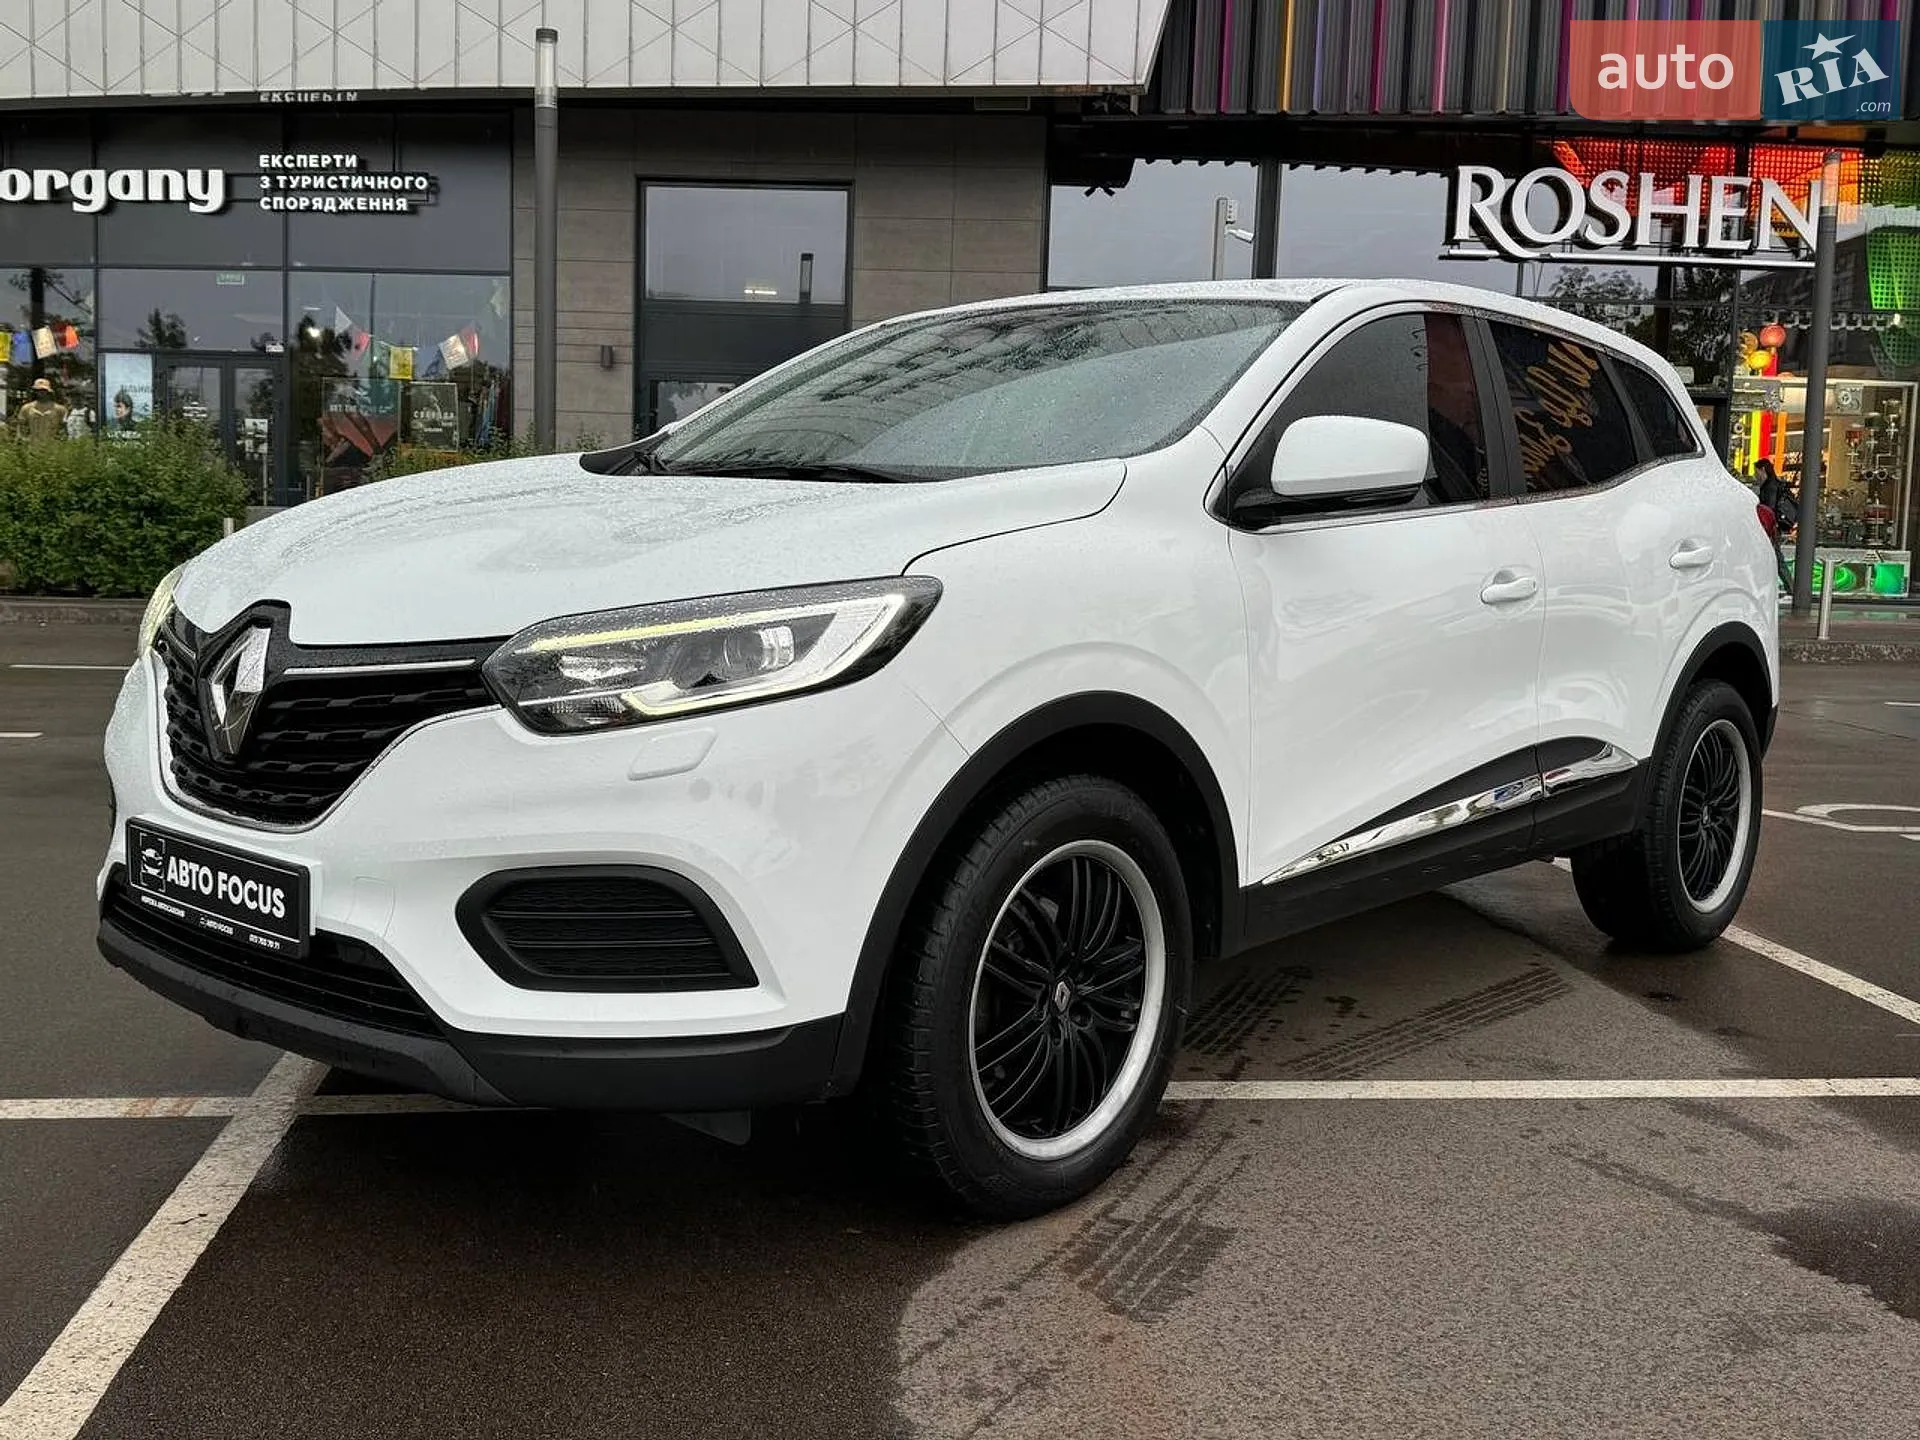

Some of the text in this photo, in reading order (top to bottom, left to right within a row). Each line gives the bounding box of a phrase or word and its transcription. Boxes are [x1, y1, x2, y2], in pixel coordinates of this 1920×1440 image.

[259, 154, 358, 169] ЕКСПЕРТИ
[277, 175, 429, 190] ТУРИСТИЧНОГО
[259, 196, 409, 212] СПОРЯДЖЕННЯ
[1453, 164, 1820, 258] ROSHEN
[167, 855, 213, 895] АВТО
[218, 871, 285, 918] FOCUS
